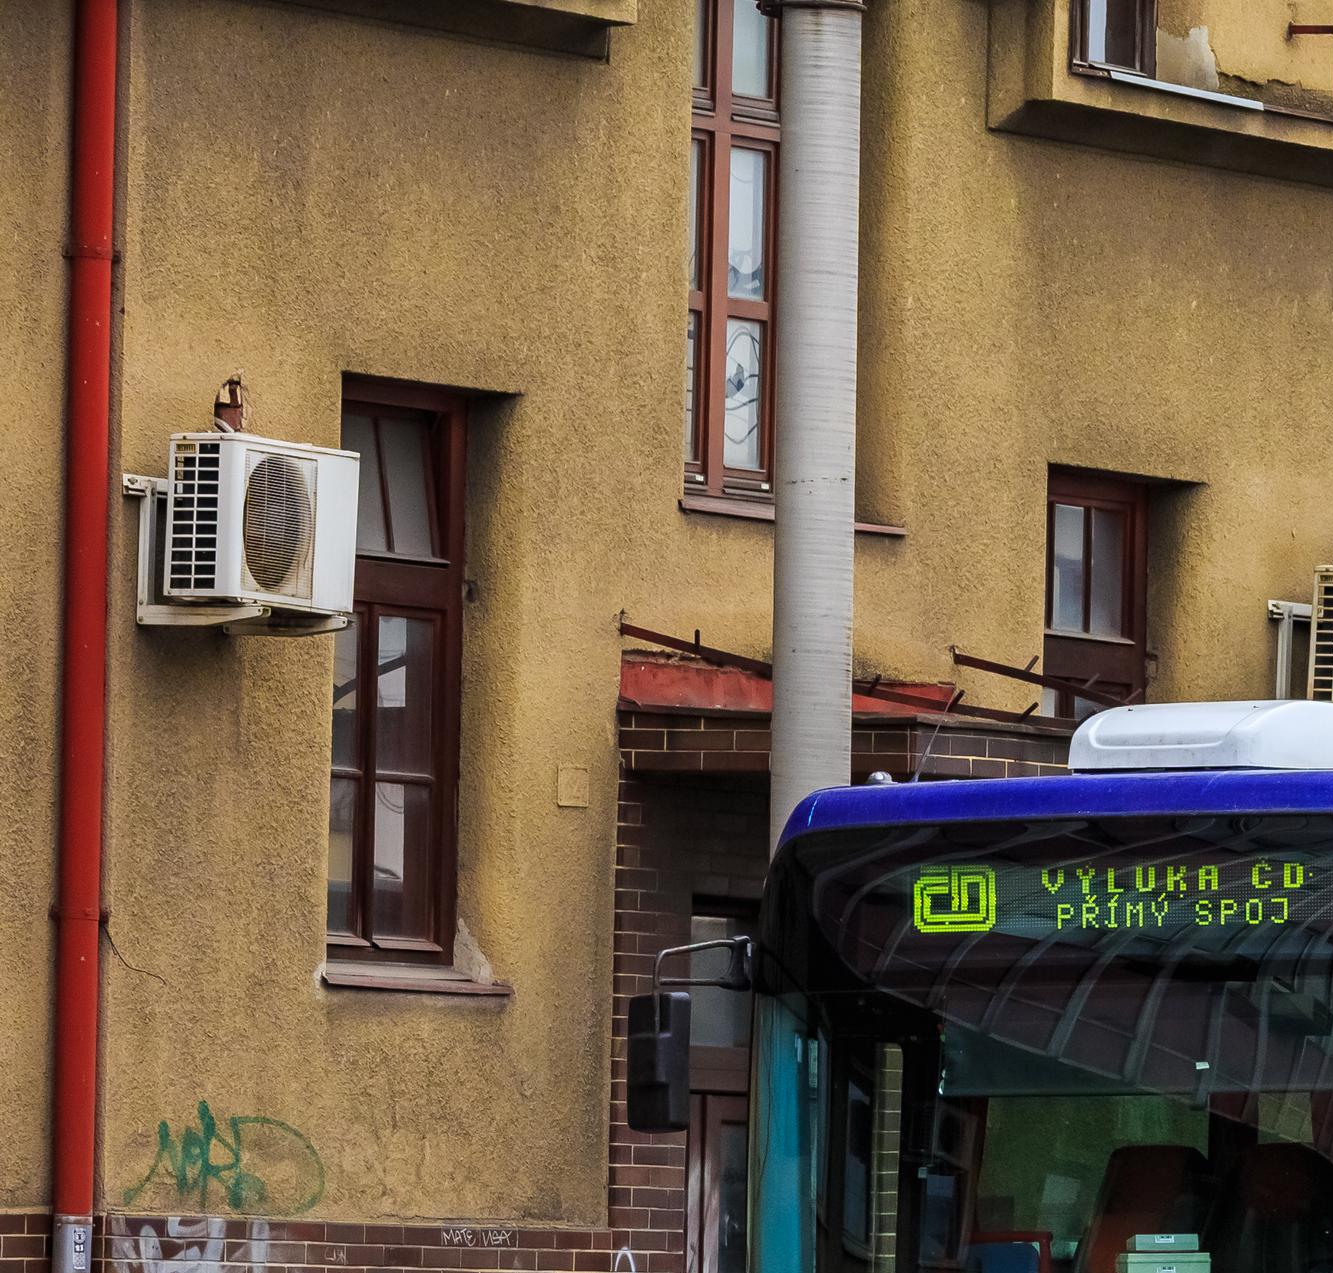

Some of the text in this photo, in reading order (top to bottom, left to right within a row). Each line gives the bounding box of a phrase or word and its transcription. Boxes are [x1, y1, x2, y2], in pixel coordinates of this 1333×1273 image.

[1041, 862, 1219, 895] VÝLUKA
[1057, 894, 1289, 930] PŘÍMÝ SPOJ
